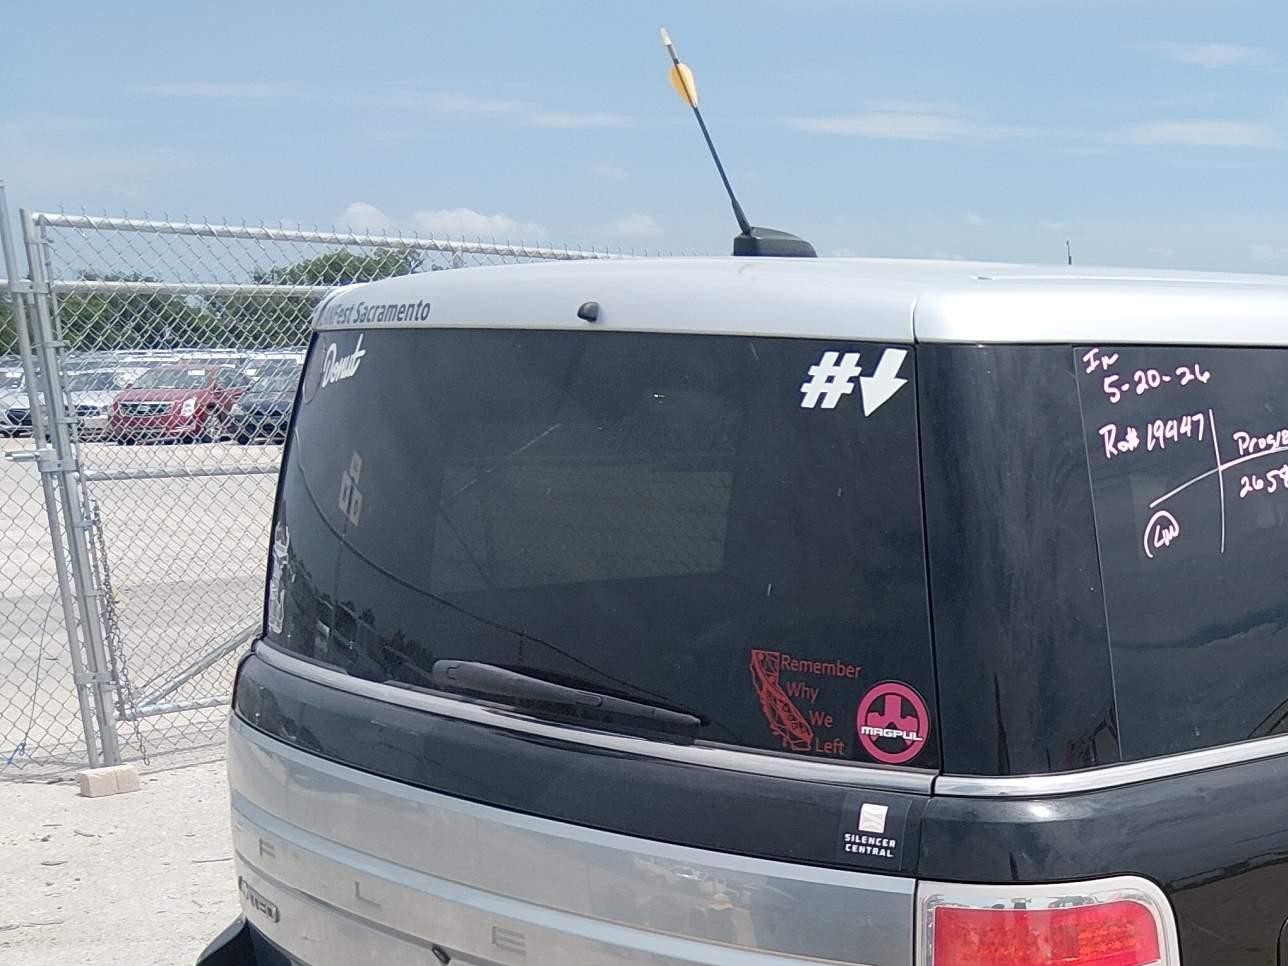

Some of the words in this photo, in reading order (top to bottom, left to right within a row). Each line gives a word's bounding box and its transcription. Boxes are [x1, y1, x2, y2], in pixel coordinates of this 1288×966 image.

[353, 299, 431, 323] Sacramento
[321, 333, 366, 388] Donut
[1103, 363, 1211, 403] 5-20-26
[781, 655, 862, 679] Remember
[786, 681, 820, 703] Why
[809, 710, 833, 728] We
[861, 726, 923, 741] MAGPUL
[815, 739, 845, 756] Left
[844, 833, 897, 849] SILENCER
[845, 843, 895, 858] CENTRAL
